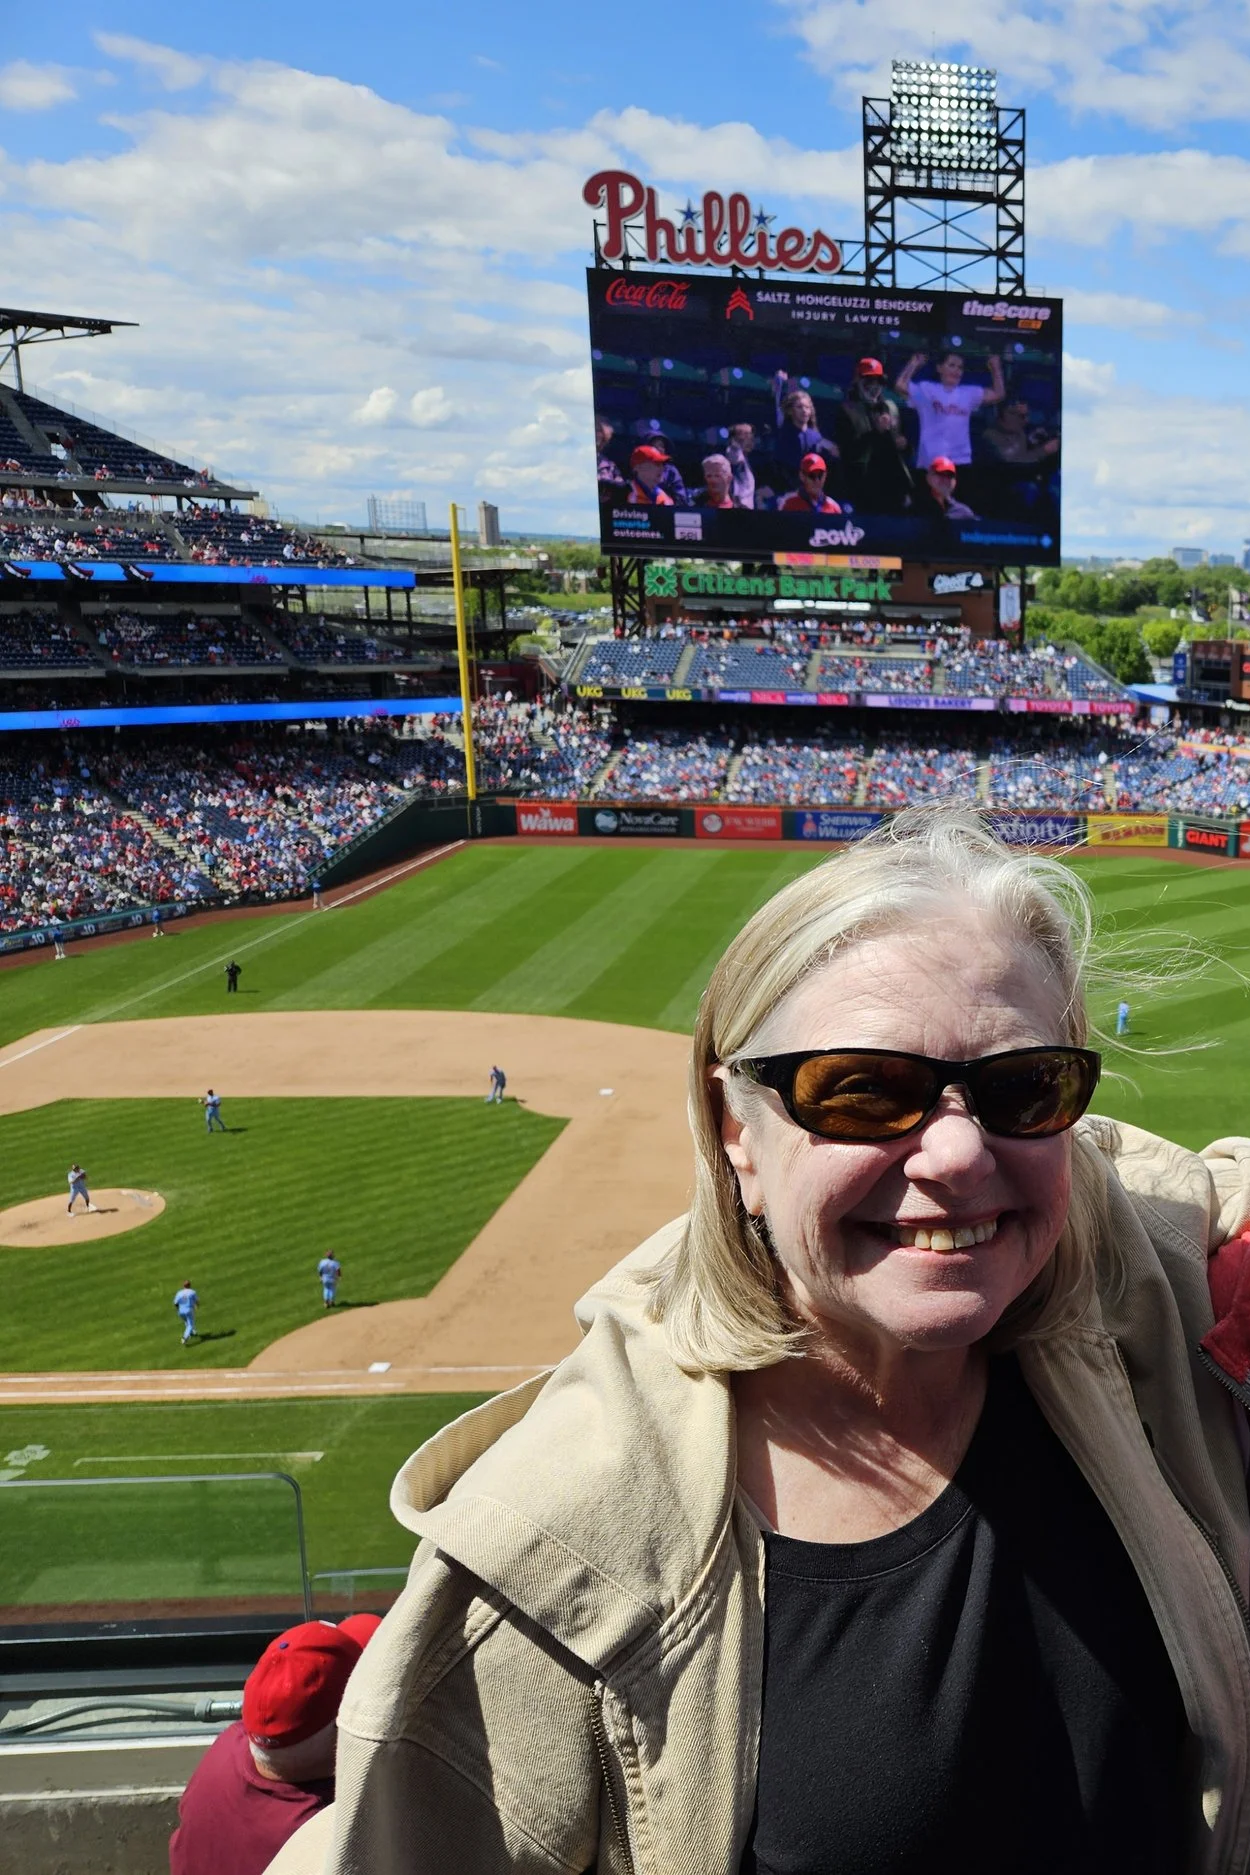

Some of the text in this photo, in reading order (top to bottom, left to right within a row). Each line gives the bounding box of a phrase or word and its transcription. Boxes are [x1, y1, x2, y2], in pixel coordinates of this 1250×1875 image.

[582, 169, 844, 274] Phillies
[605, 276, 692, 310] Coca-Cola
[756, 290, 934, 313] SALTZ MONGELUZZI BENDESKY
[791, 309, 901, 326] INJURY LAWYERS
[962, 300, 1052, 320] theScore
[612, 508, 649, 522] Driving
[812, 526, 864, 547] PGW
[681, 571, 892, 601] Citizens Bank Park
[576, 684, 603, 698] UKG
[621, 686, 648, 699] UKG
[666, 688, 692, 701] UKG
[519, 812, 575, 833] Wawa
[619, 811, 680, 826] NovaCare
[820, 813, 872, 826] SHERWIN
[1186, 830, 1228, 849] GIANT
